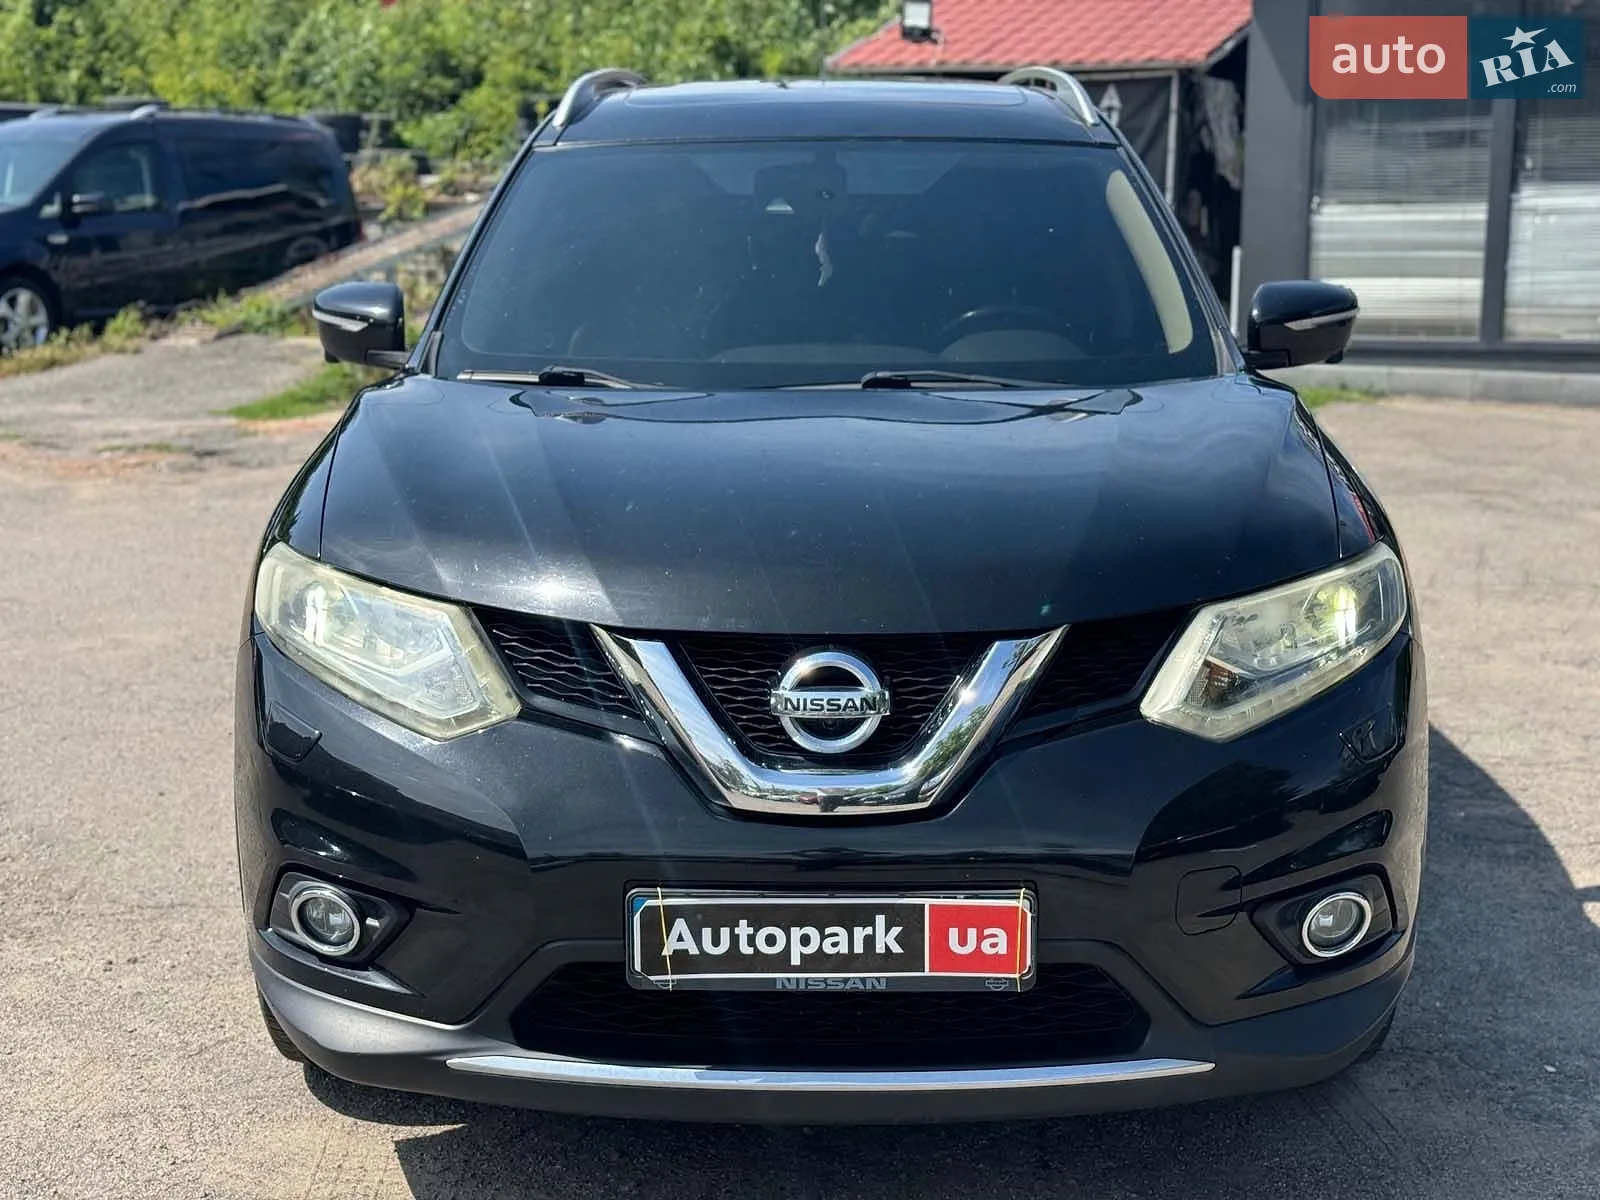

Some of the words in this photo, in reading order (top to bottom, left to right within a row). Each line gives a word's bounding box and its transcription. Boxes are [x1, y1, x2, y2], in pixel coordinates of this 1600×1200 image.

[783, 697, 878, 712] NISSAN
[662, 914, 905, 966] Autopark
[948, 926, 1009, 955] ua
[775, 976, 887, 990] NISSAN
